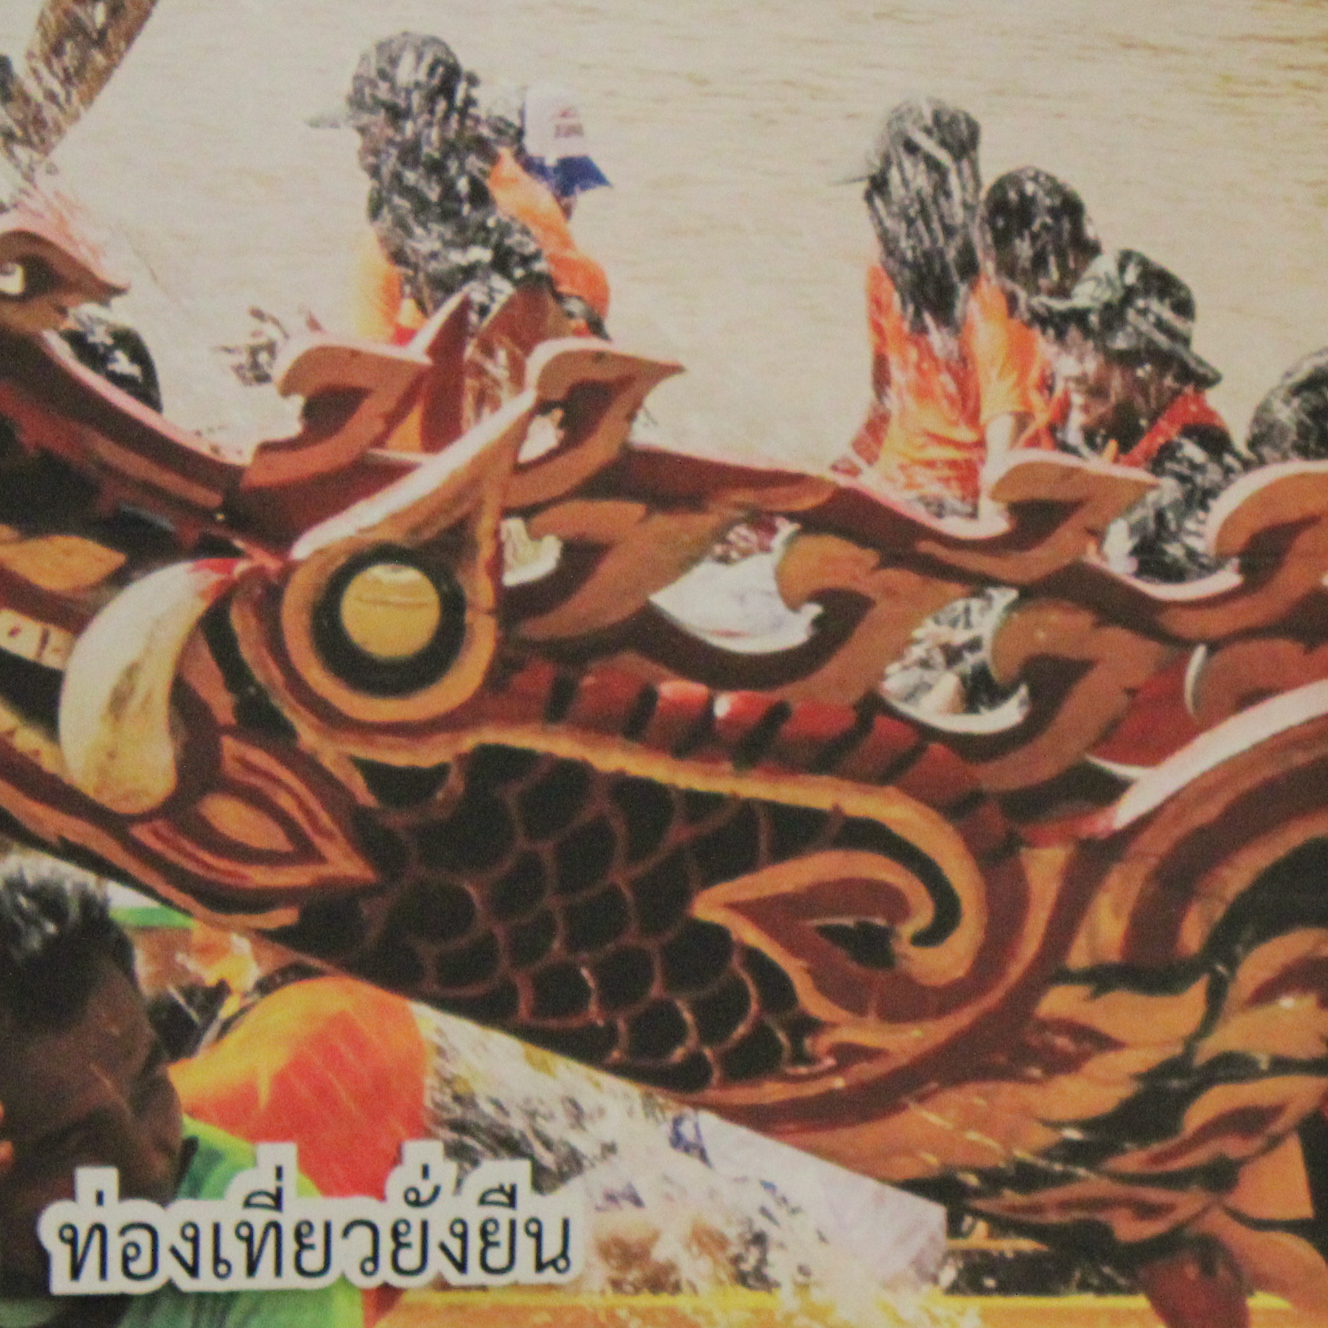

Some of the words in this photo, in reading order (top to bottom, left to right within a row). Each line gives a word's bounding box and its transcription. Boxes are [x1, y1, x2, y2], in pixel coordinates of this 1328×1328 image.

[57, 1163, 572, 1282] ท่องเที่ยวยั่งยืน
